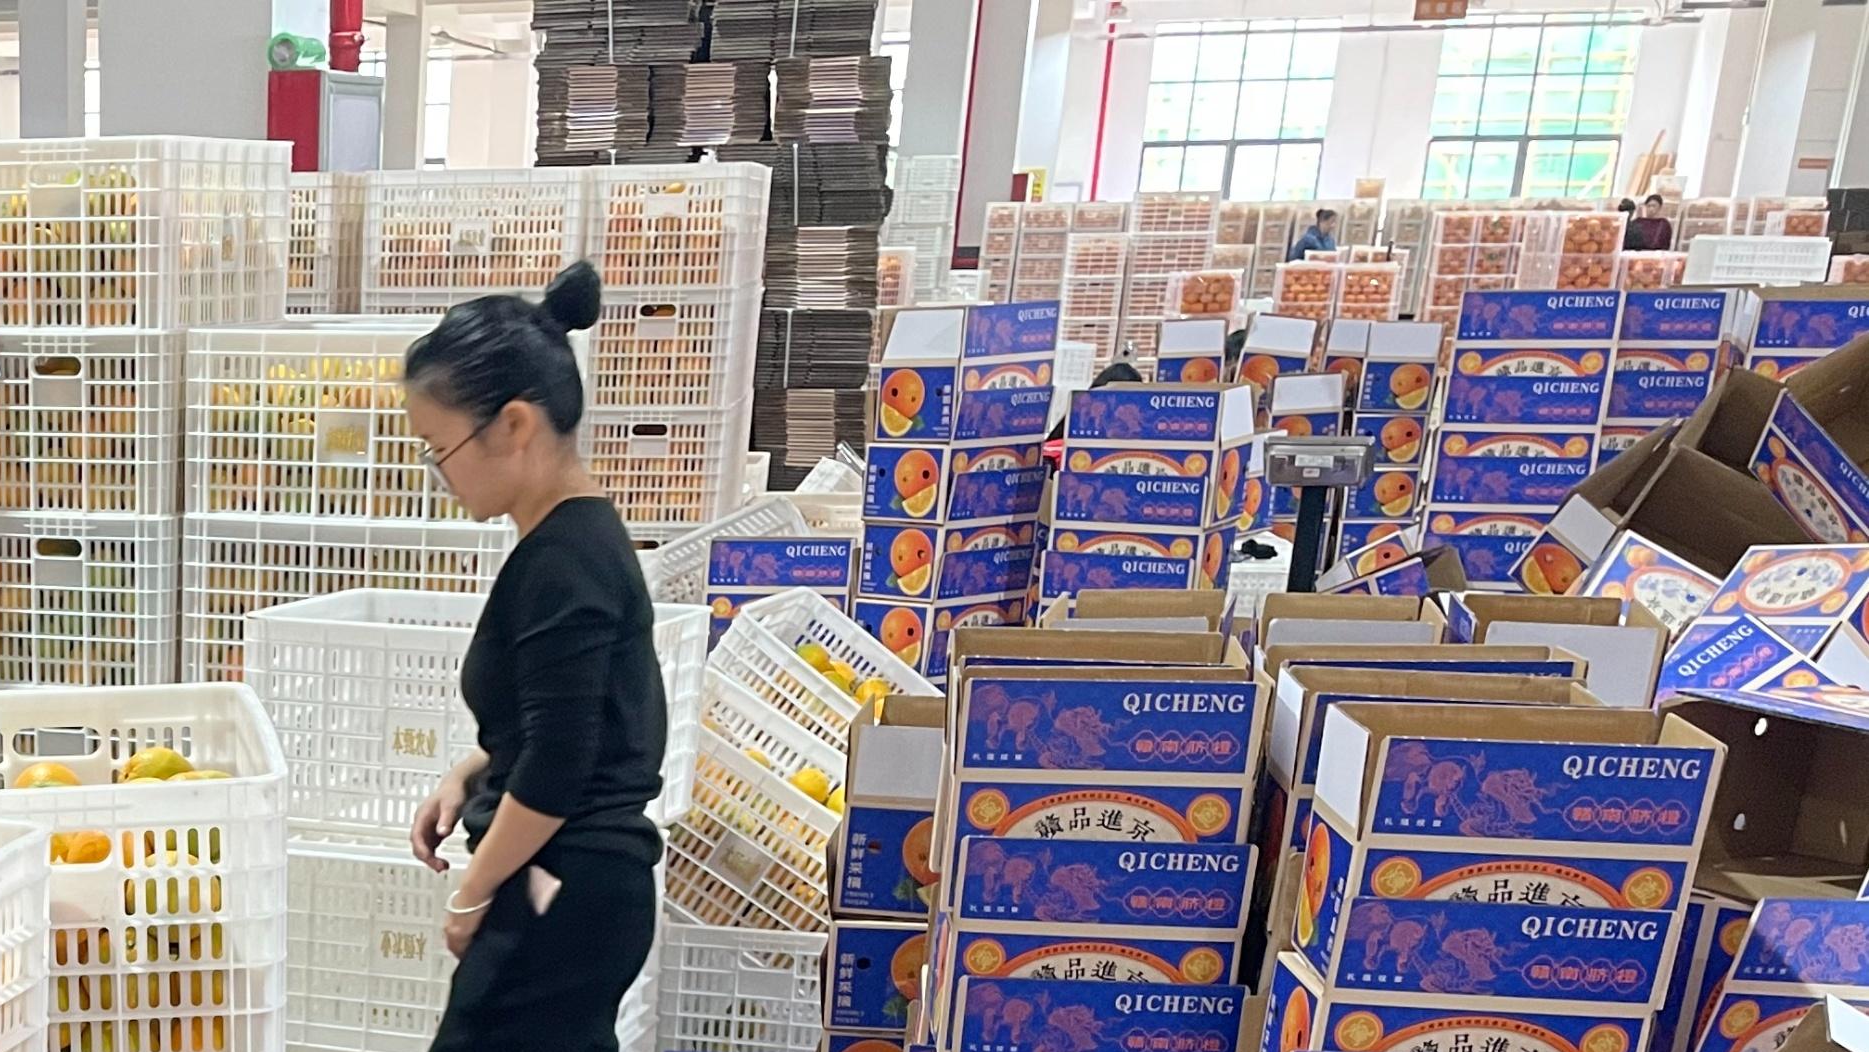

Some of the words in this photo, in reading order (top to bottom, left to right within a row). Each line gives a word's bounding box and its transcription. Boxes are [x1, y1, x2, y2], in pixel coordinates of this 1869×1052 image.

[1547, 294, 1615, 310] QICHENG
[1653, 296, 1721, 311] QICHENG
[1532, 380, 1600, 395] QICHENG
[1638, 375, 1705, 389] QICHENG
[1150, 396, 1216, 410] QICHENG
[1519, 461, 1586, 476] QICHENG
[1136, 481, 1201, 495] QICHENG
[785, 544, 847, 558] QICHENG
[1122, 561, 1186, 576] QICHENG
[1677, 623, 1756, 679] QICHENG
[1122, 693, 1245, 714] QICHENG
[1563, 755, 1701, 781] QICHENG
[1118, 852, 1240, 873] QICHENG
[1521, 916, 1658, 942] QICHENG
[1115, 994, 1234, 1015] QICHENG
